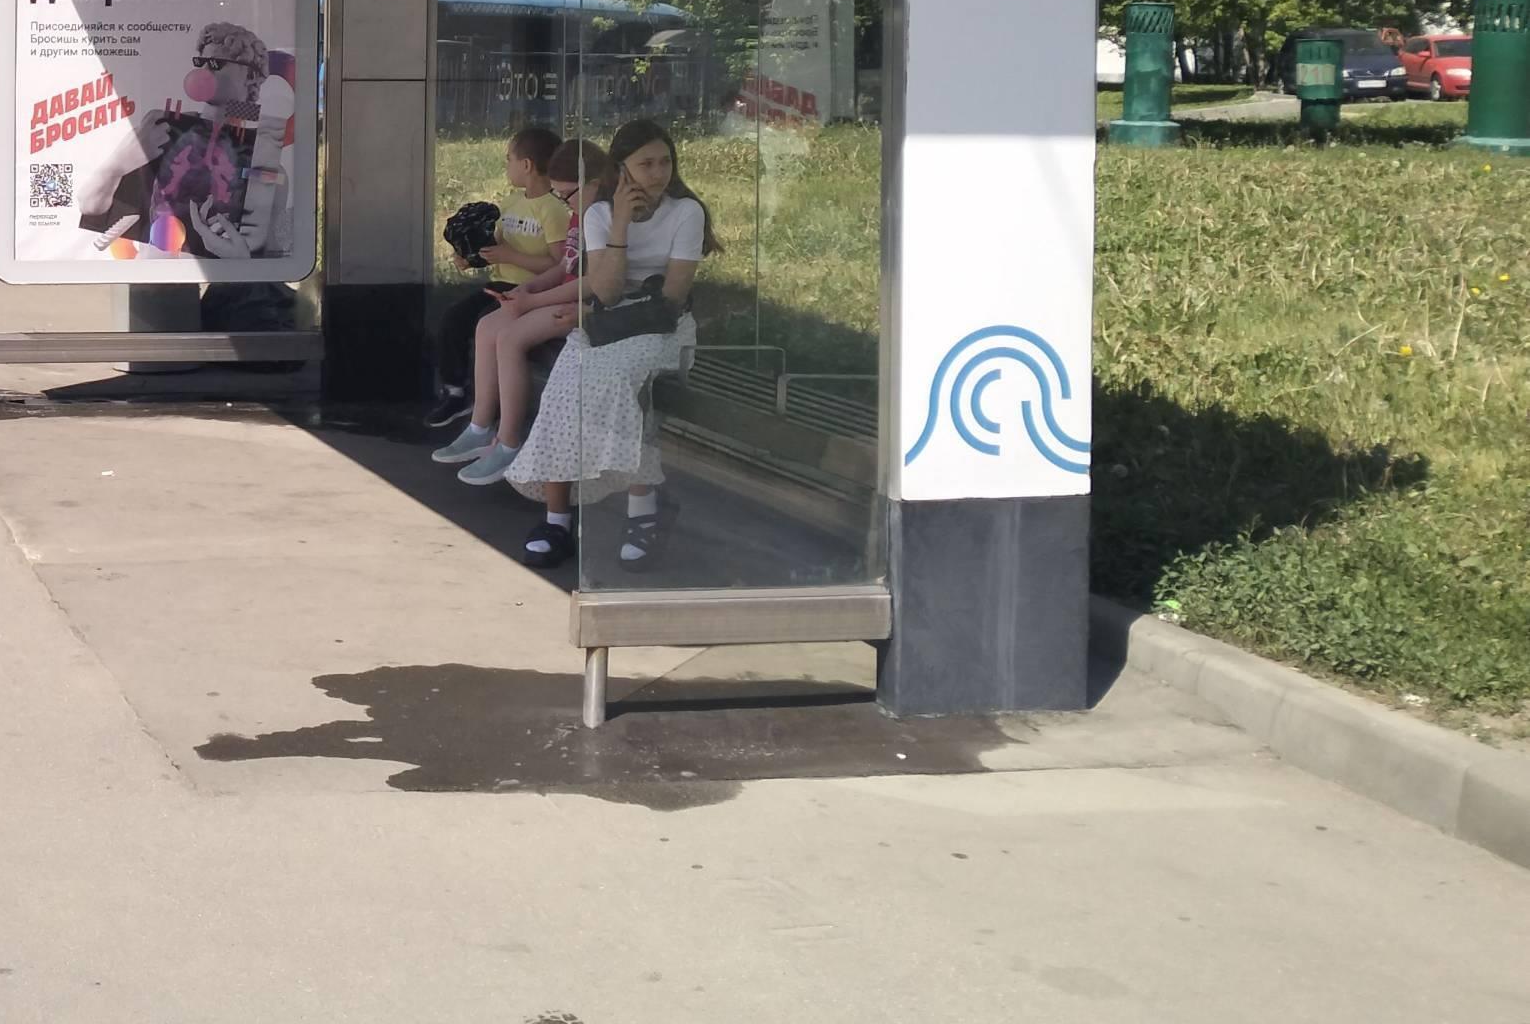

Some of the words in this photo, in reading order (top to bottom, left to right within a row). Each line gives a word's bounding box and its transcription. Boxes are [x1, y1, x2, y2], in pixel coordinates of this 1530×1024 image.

[30, 21, 116, 33] Присоединяйся
[118, 23, 125, 31] к
[126, 21, 193, 33] сообществу.
[30, 34, 79, 45] Бросишь
[81, 36, 118, 46] курить
[120, 35, 141, 44] сам
[30, 48, 37, 56] и
[39, 48, 78, 59] другим
[81, 48, 142, 57] поможешь.
[31, 69, 114, 130] ДАВАЙ
[30, 96, 136, 155] БРОСАТЬ
